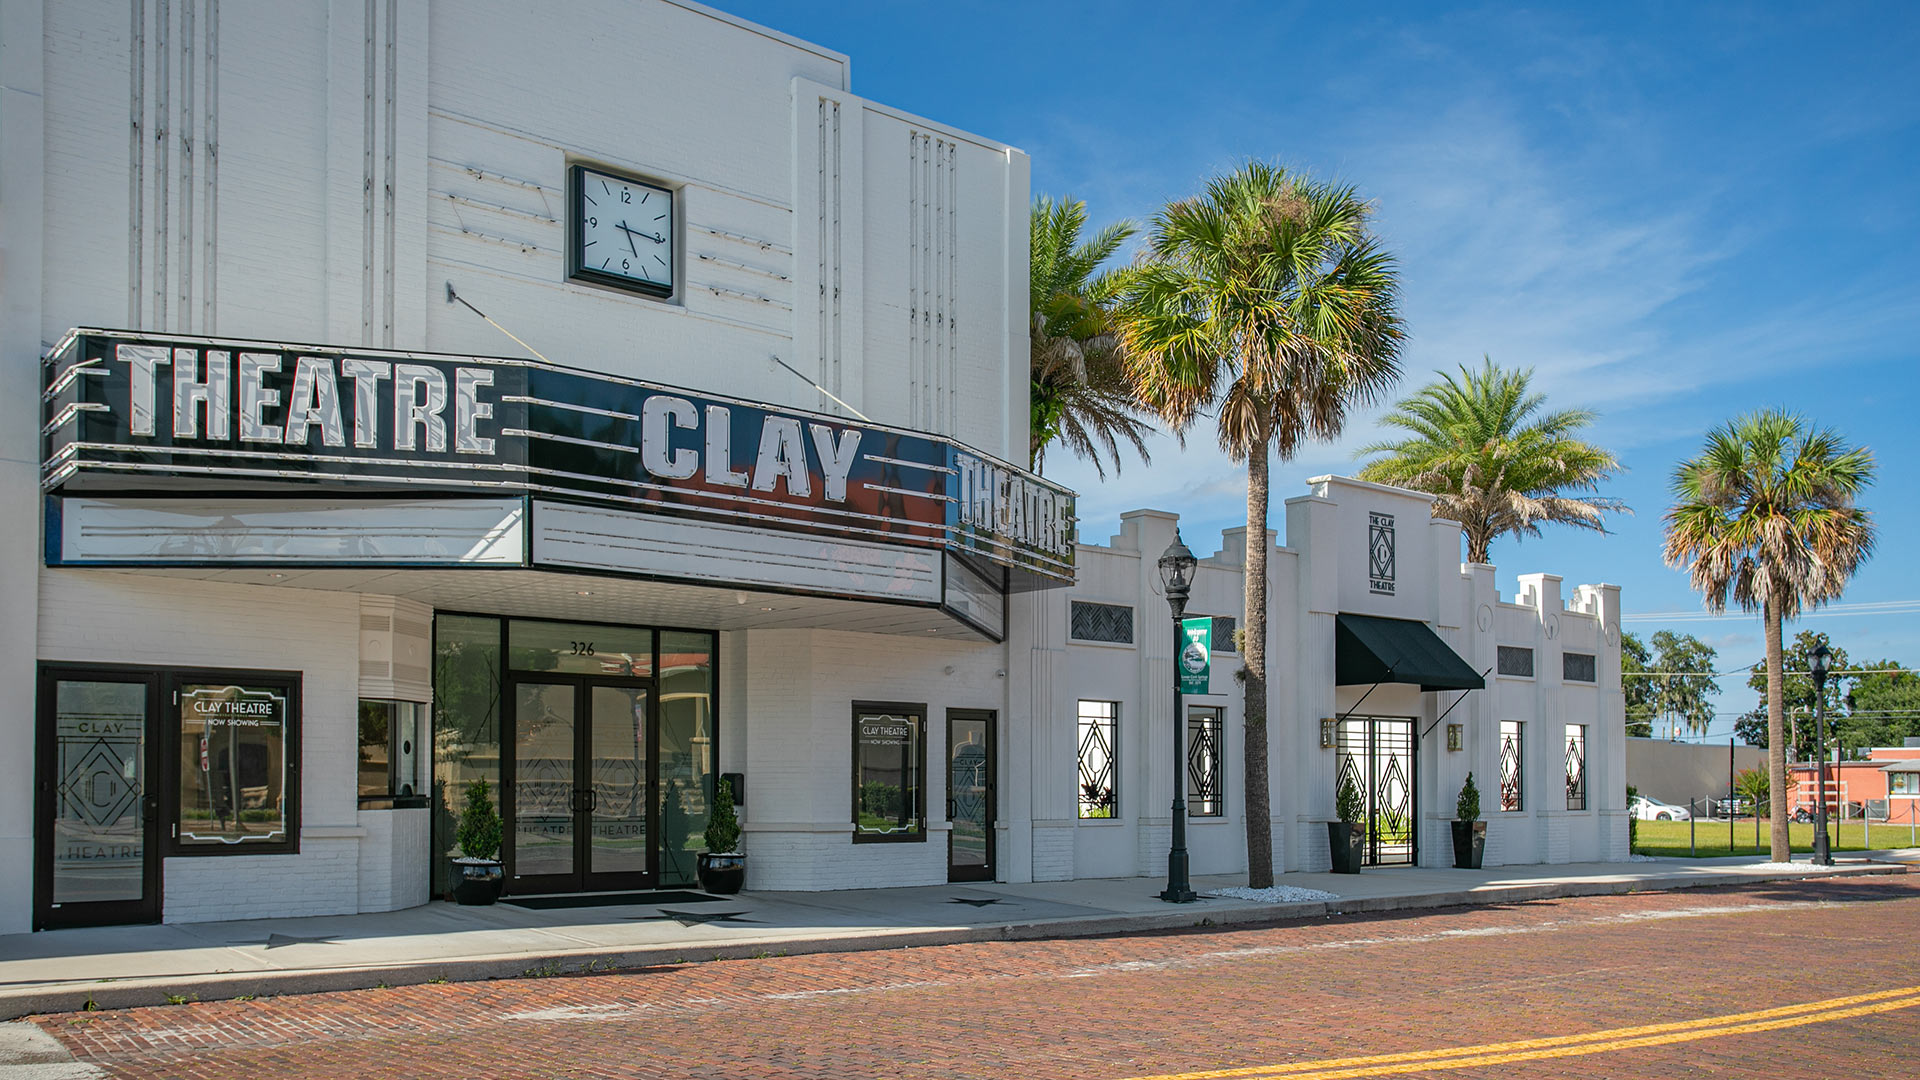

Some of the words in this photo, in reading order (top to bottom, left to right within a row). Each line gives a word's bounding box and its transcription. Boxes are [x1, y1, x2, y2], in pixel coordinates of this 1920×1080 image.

[621, 191, 631, 204] 12
[589, 217, 598, 228] 9
[622, 258, 630, 270] 6
[115, 343, 496, 455] THEATRE
[641, 395, 863, 503] CLAY
[954, 453, 1071, 556] THEATRE
[1369, 516, 1379, 525] THE
[1381, 518, 1395, 528] CLAY
[1369, 580, 1395, 592] THEATRE
[570, 641, 595, 656] 326
[193, 701, 222, 713] CLAY
[225, 702, 272, 715] THEATRE
[78, 722, 125, 734] CLAY
[227, 719, 259, 727] SHOWING
[862, 726, 879, 735] CLAY
[880, 726, 908, 736] THEATRE
[592, 825, 646, 836] THEATRE
